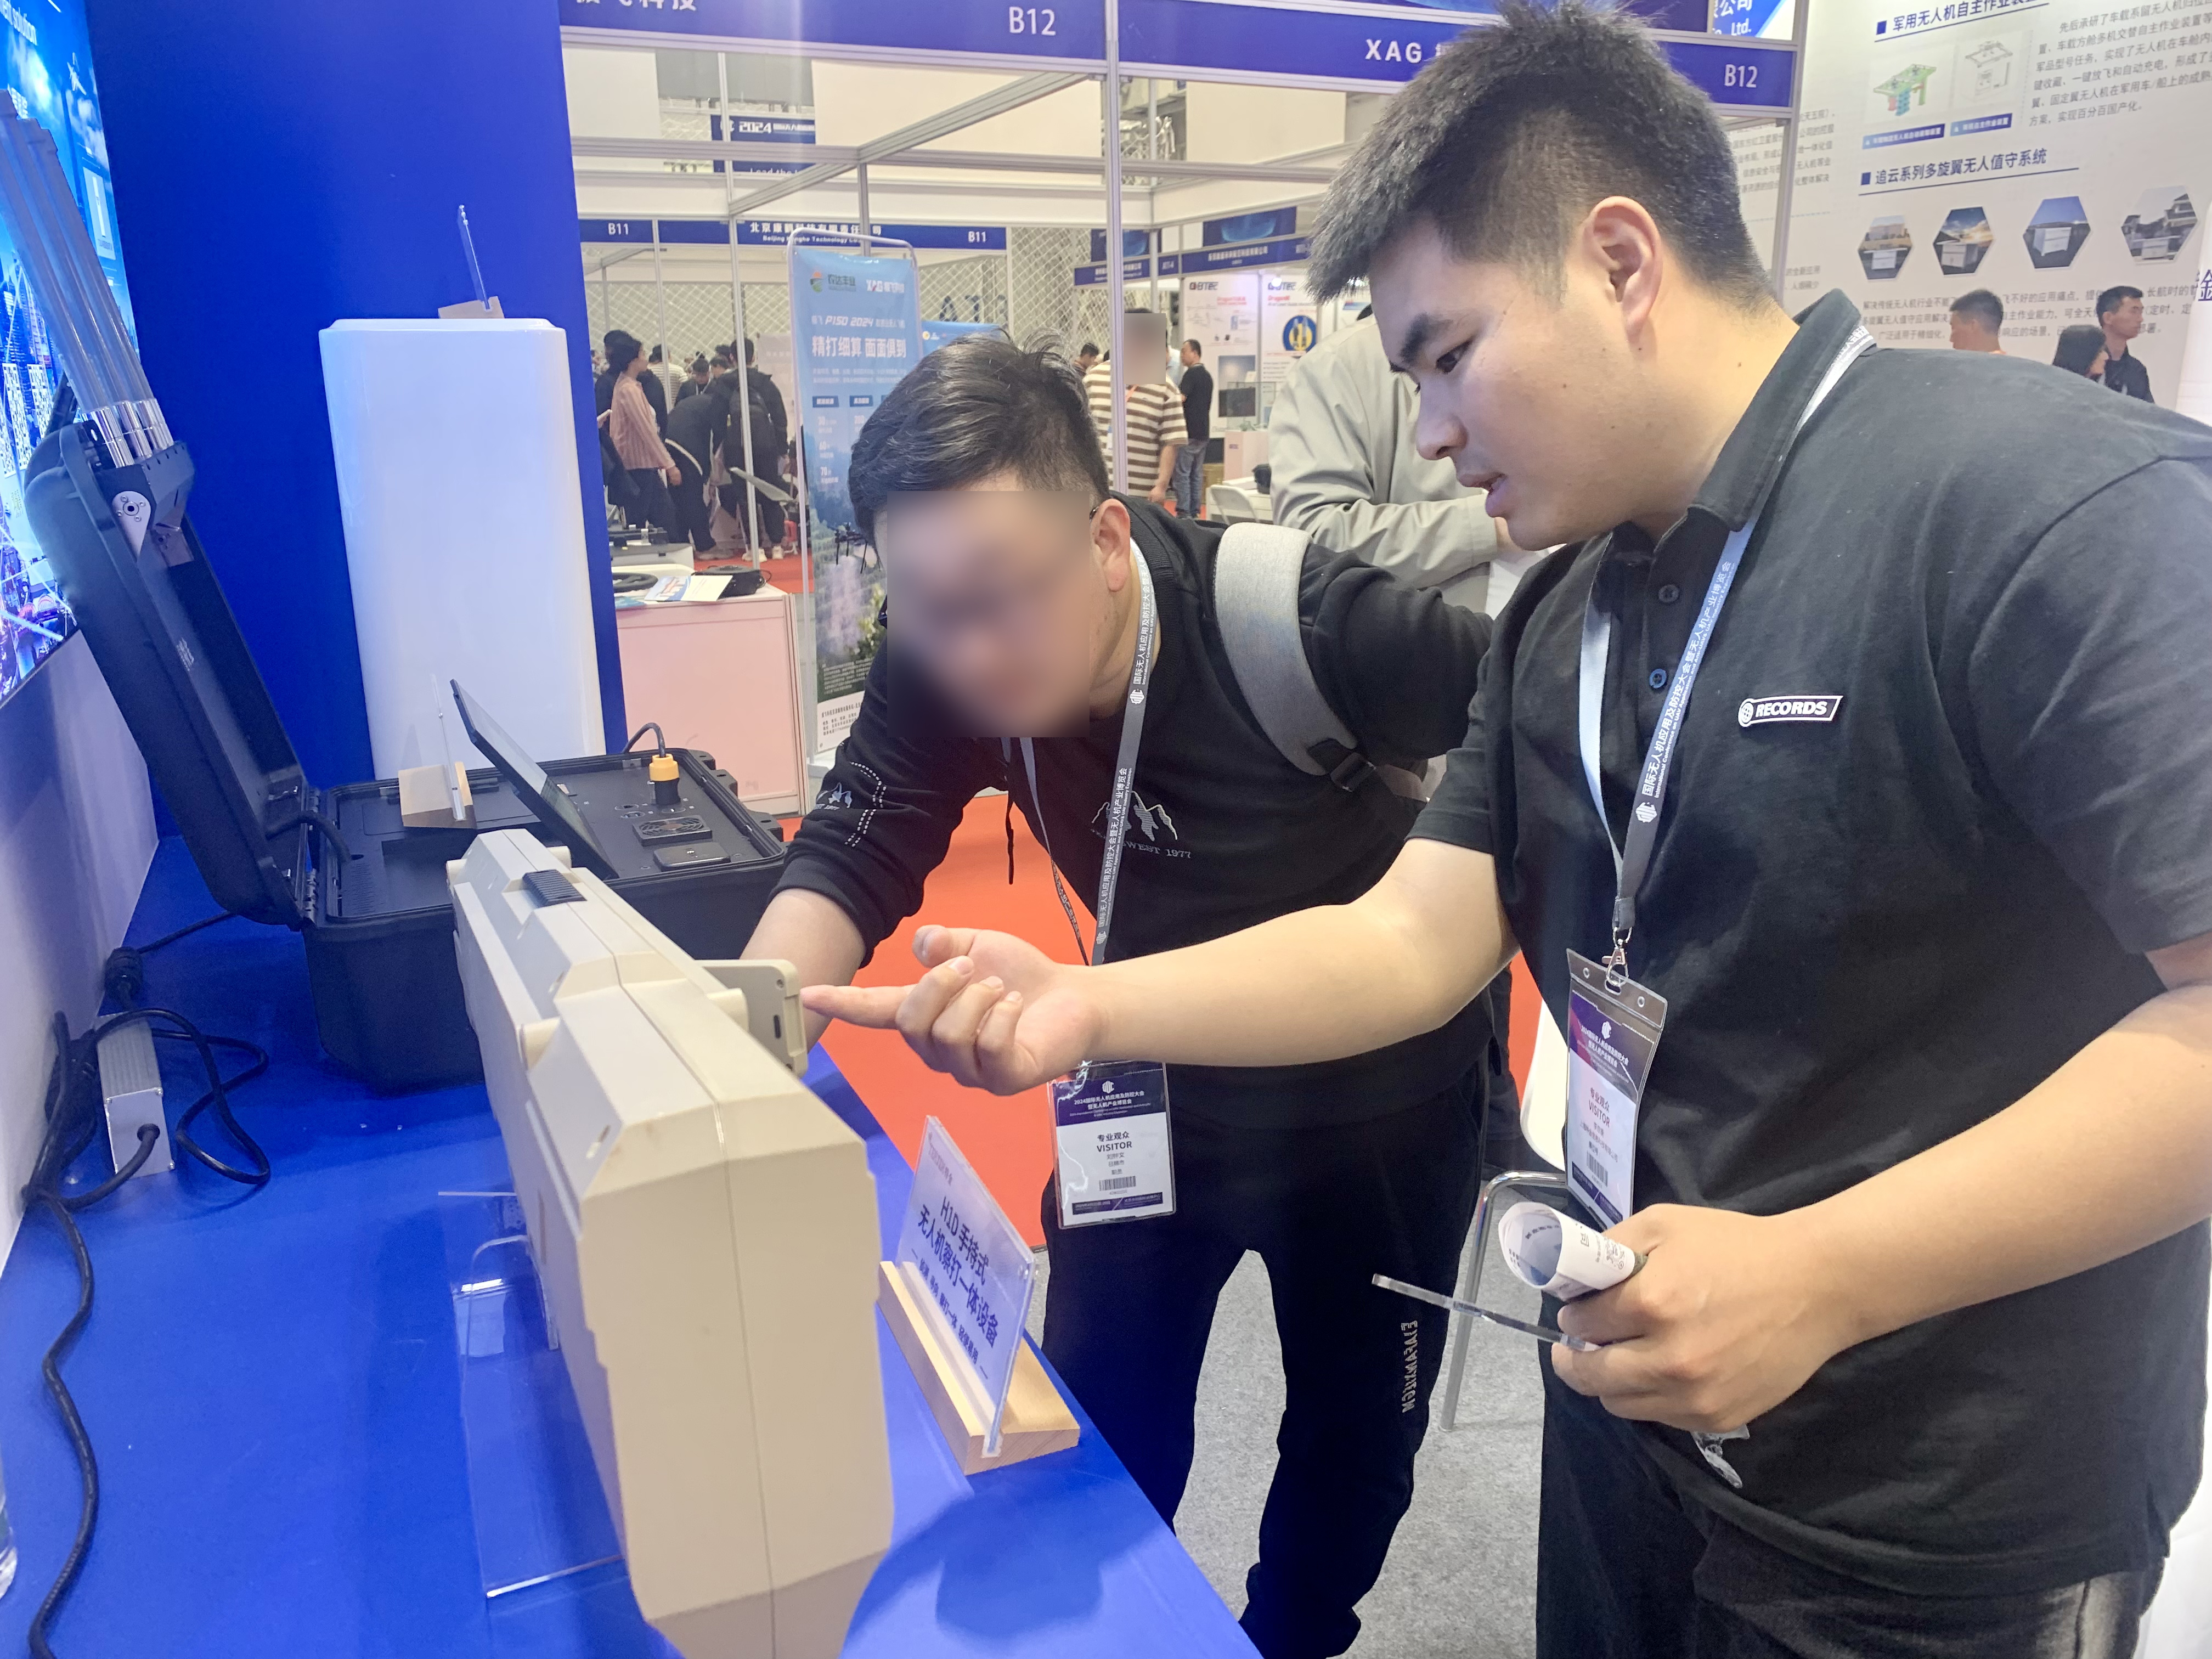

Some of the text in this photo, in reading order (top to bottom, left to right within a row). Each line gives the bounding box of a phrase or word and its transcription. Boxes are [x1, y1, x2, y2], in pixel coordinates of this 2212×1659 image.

[1008, 7, 1056, 37] B12
[1731, 18, 1752, 36] Ltd.
[1893, 0, 2038, 31] 军用无人机自主作业
[1365, 38, 1422, 63] XAG
[1724, 64, 1758, 88] B12
[738, 121, 772, 134] 2024
[1875, 148, 2049, 185] 追云系列多旋翼无人值守系统
[607, 223, 629, 235] B11
[967, 230, 987, 243] B11
[812, 335, 907, 358] 精打细算 面面俱到
[1756, 701, 1828, 718] RECORDS
[1662, 729, 1675, 763] Conference
[1588, 1100, 1610, 1128] VISITOR
[1096, 1141, 1133, 1153] VISITOR
[1097, 1131, 1130, 1142] 专业观众
[958, 1223, 989, 1286] 手持式
[918, 1204, 999, 1348] 无人机察打一体设备
